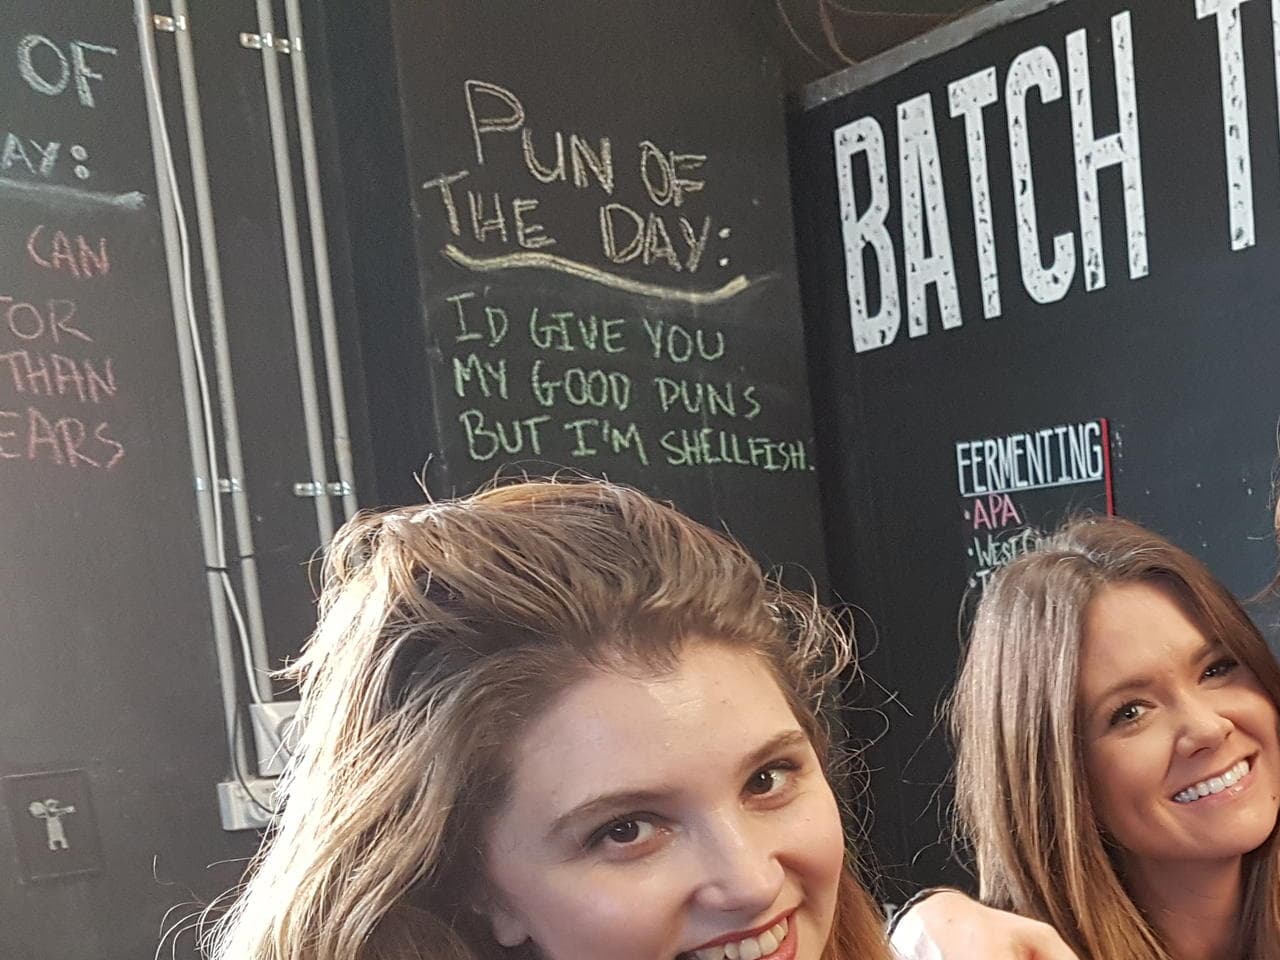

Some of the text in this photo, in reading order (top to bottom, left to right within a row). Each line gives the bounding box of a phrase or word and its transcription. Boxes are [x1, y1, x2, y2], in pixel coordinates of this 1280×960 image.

[16, 33, 118, 107] OF
[464, 79, 707, 207] PUN OF
[832, 9, 1149, 354] BATCH
[27, 224, 111, 279] CAN
[422, 170, 731, 273] THE DAY:
[0, 296, 94, 344] OR
[446, 285, 726, 363] I'D GIVE YOU
[0, 350, 117, 403] THAN
[452, 352, 761, 420] MY GOOD PUNS
[459, 408, 816, 472] BUT I'M SHELLFISH.
[956, 421, 1104, 494] FERMENTING
[972, 491, 1023, 531] APA
[974, 533, 1018, 567] WEST
